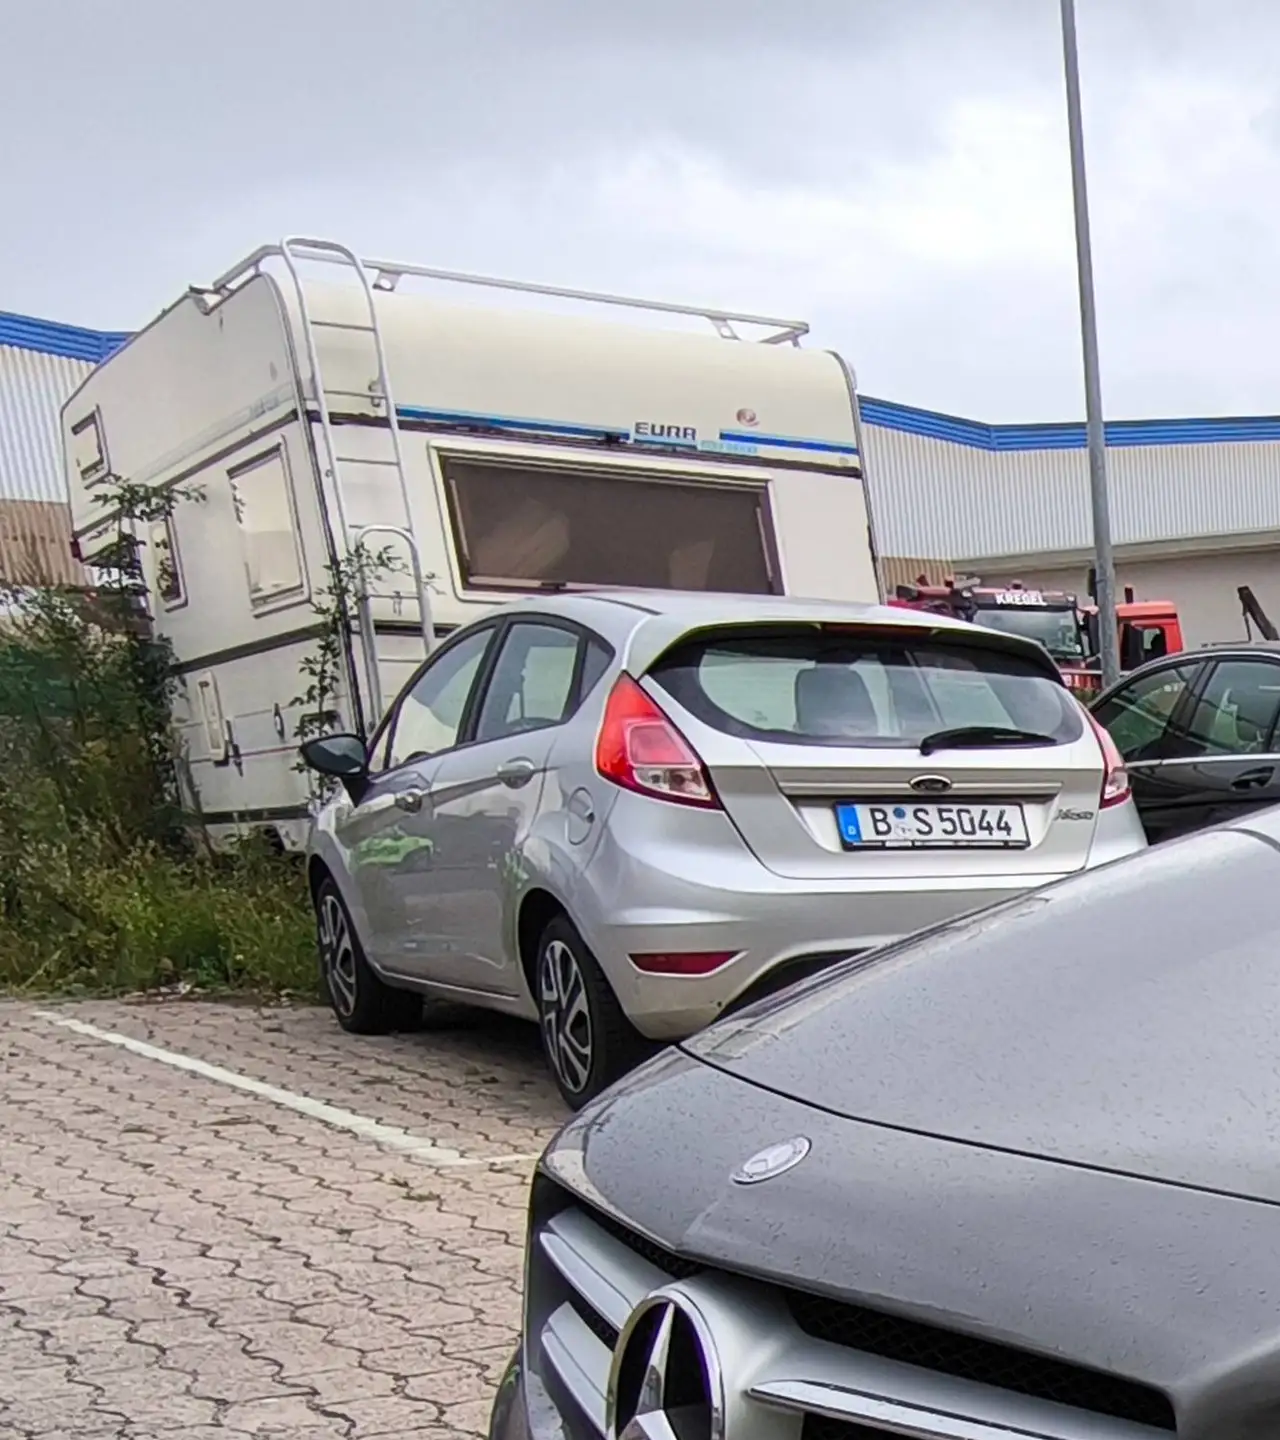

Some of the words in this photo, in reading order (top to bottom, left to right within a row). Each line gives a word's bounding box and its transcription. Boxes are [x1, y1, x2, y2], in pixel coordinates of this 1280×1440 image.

[634, 421, 697, 440] EURA
[995, 592, 1048, 606] KREGEL
[869, 807, 892, 836] B
[913, 808, 933, 836] S
[936, 808, 1012, 837] 5044
